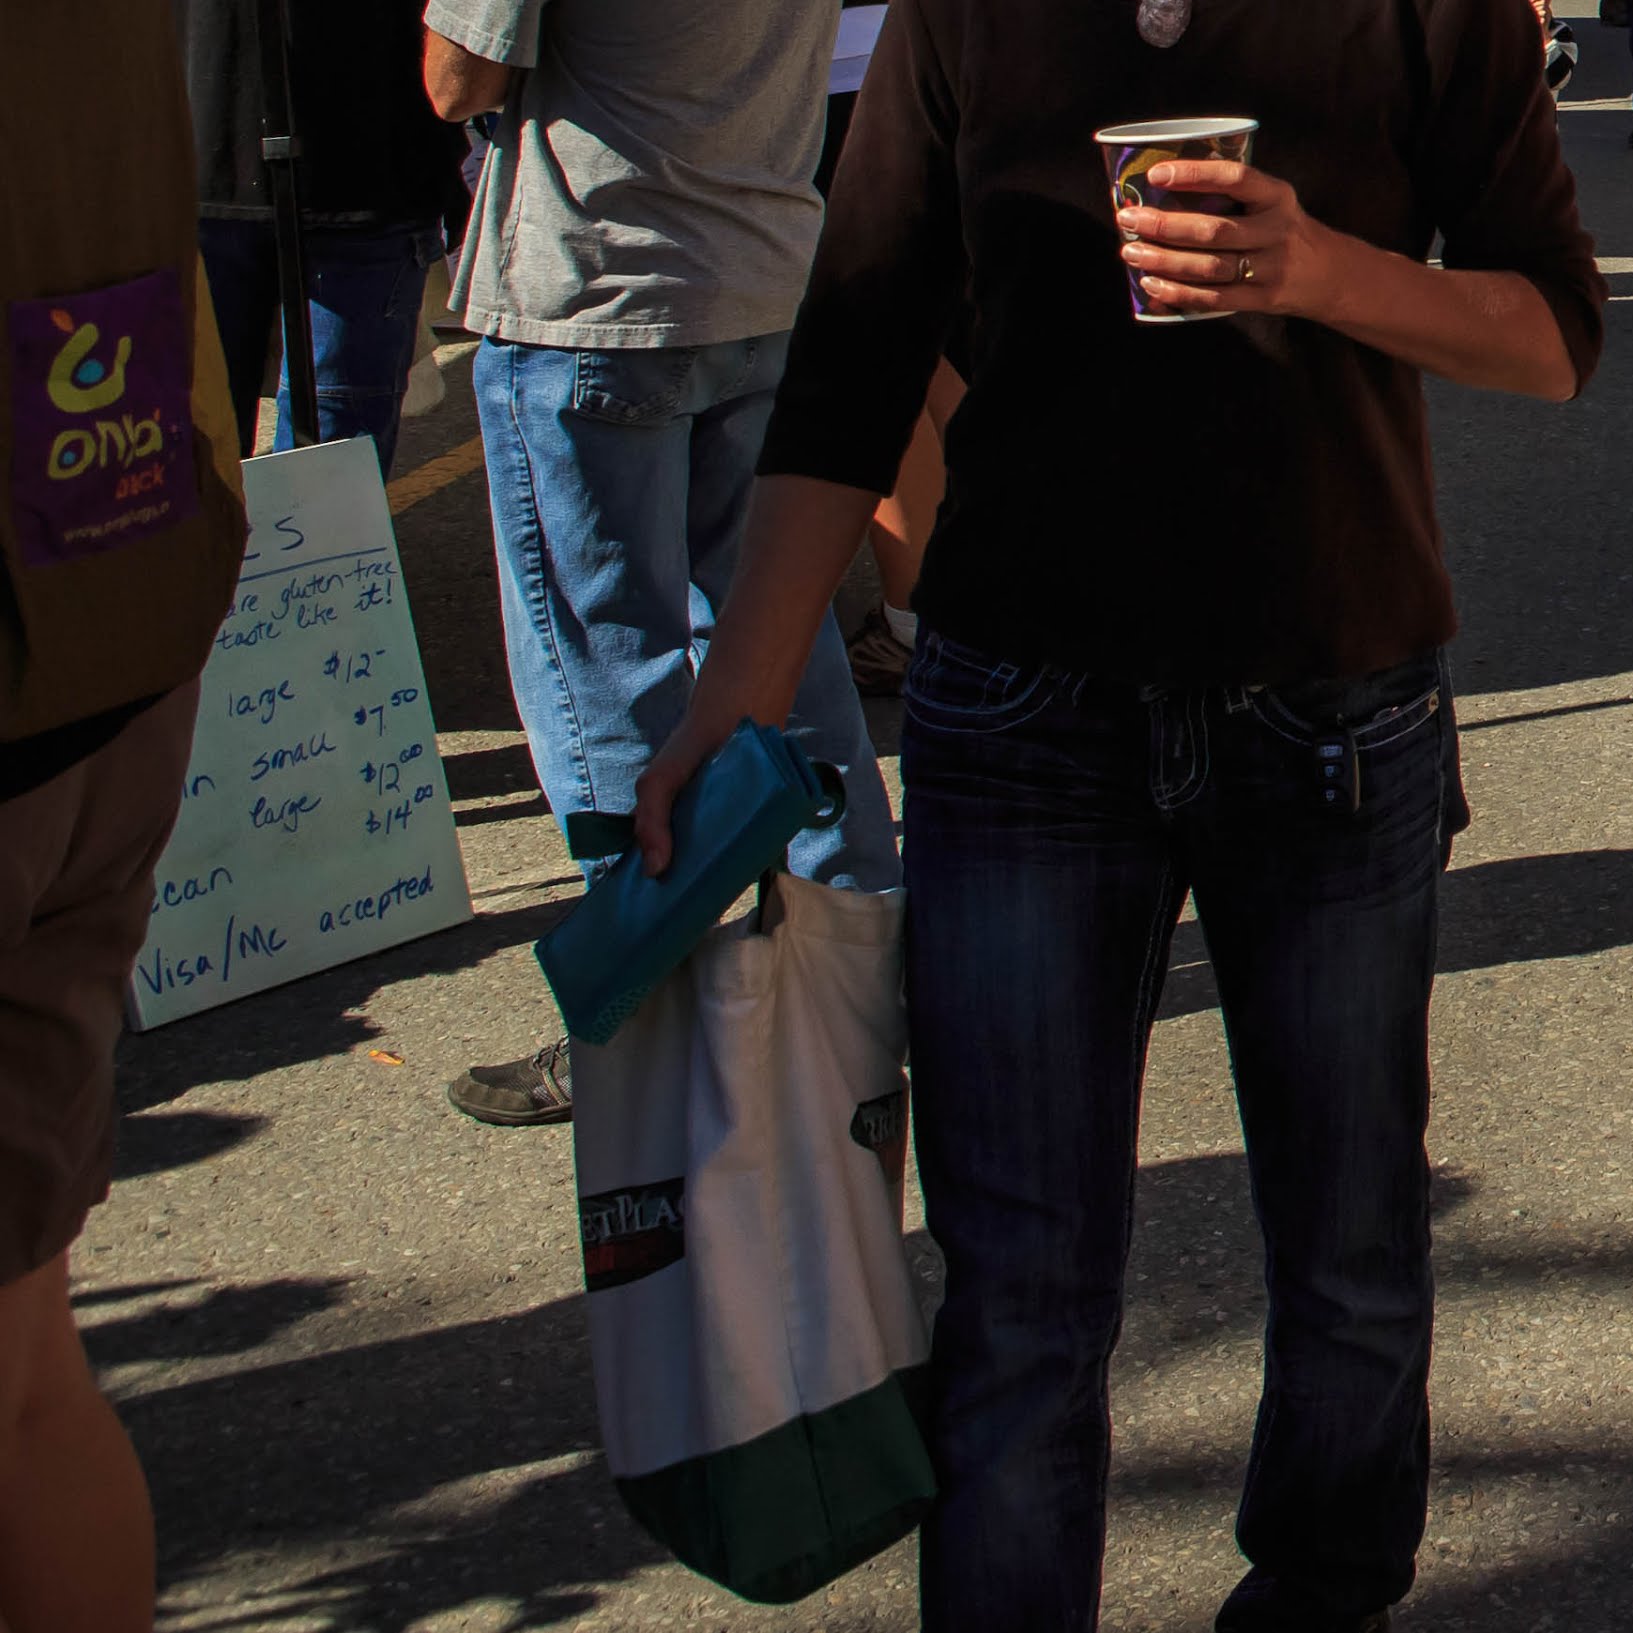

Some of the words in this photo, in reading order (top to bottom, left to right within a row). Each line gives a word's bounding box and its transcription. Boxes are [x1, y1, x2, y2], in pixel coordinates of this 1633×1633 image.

[216, 621, 281, 649] taste
[297, 602, 337, 629] like
[354, 578, 393, 612] it!
[229, 680, 295, 724] large
[251, 732, 336, 780] small
[250, 797, 322, 832] large
[320, 866, 434, 933] accepted
